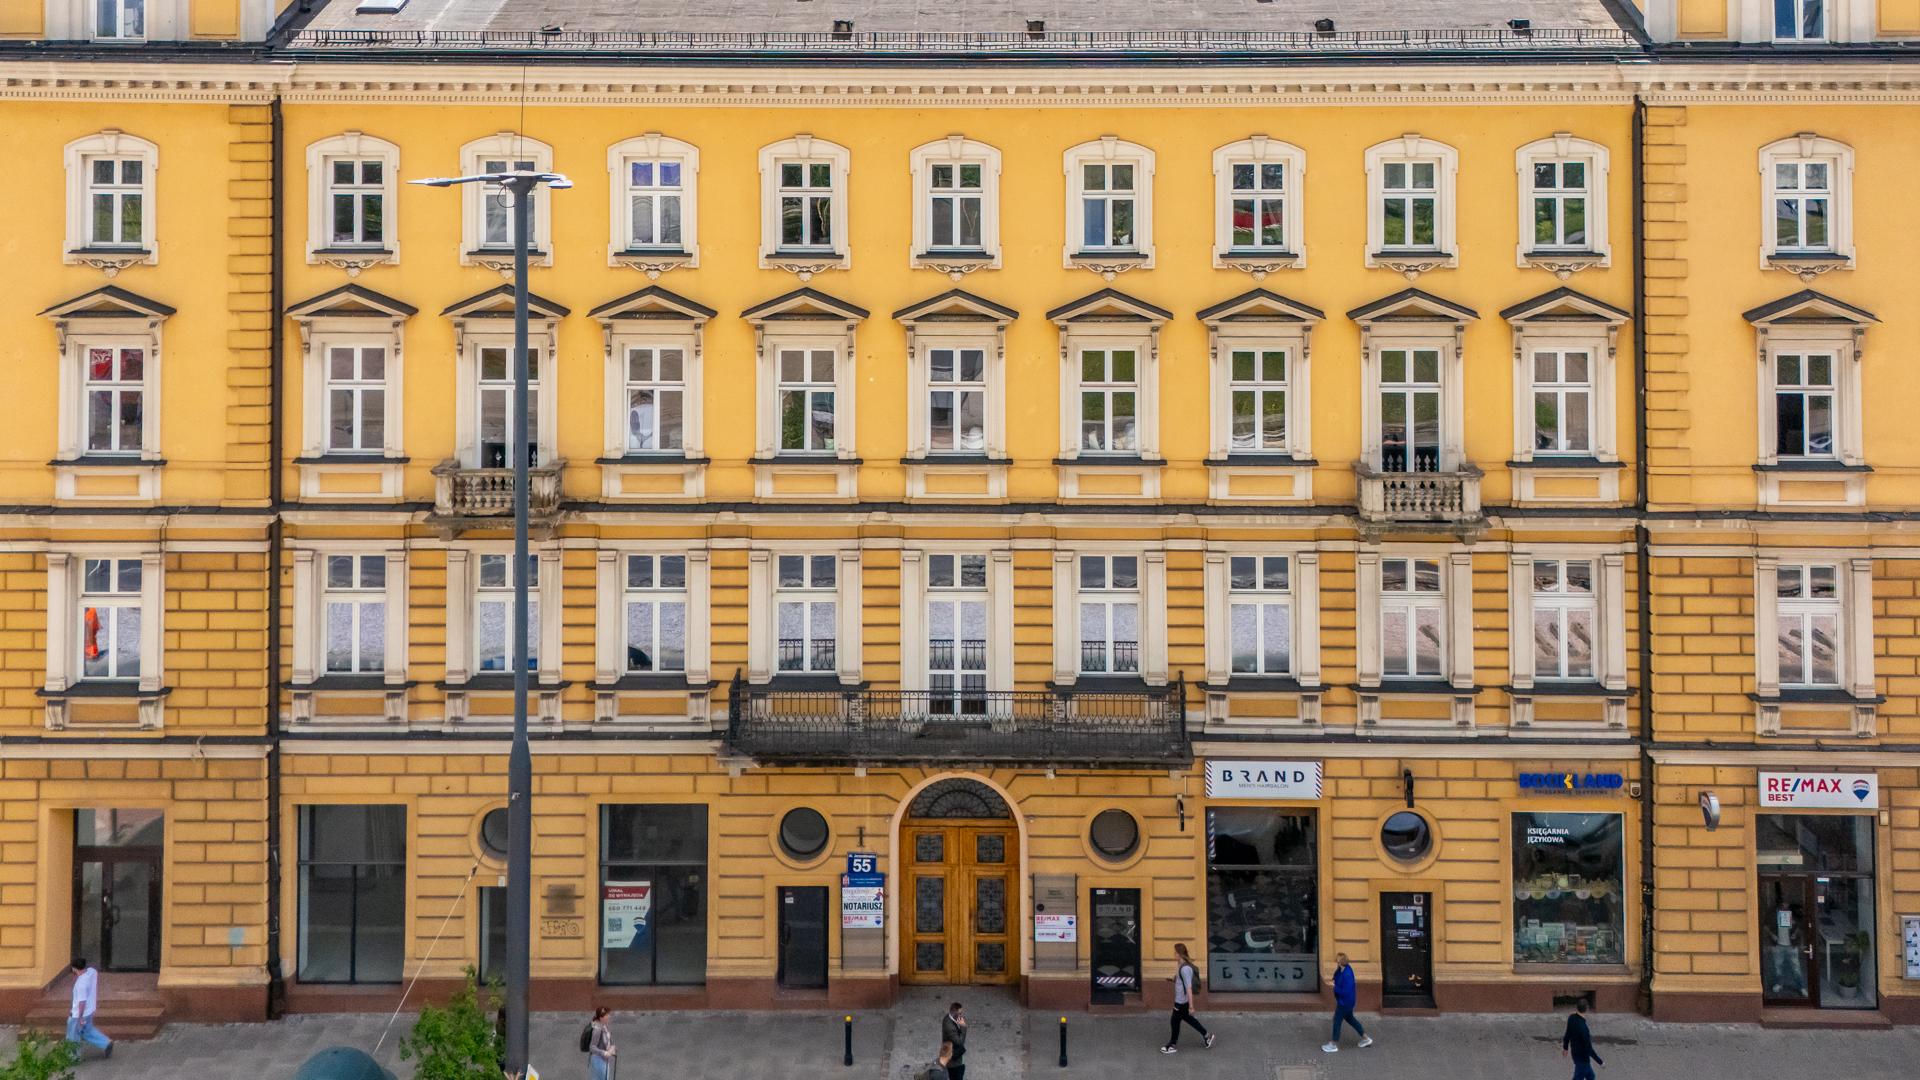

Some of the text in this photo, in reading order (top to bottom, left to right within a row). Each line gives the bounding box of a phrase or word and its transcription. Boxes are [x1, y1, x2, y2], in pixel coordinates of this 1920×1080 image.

[1222, 770, 1305, 783] BRAND
[1767, 778, 1842, 793] RE/MAX
[1768, 794, 1795, 802] BEST
[1527, 828, 1569, 836] KSIĘGARNIA
[1527, 836, 1564, 844] JĘZYKOWA
[852, 858, 872, 872] 55
[844, 902, 882, 910] NOTARIUSZ
